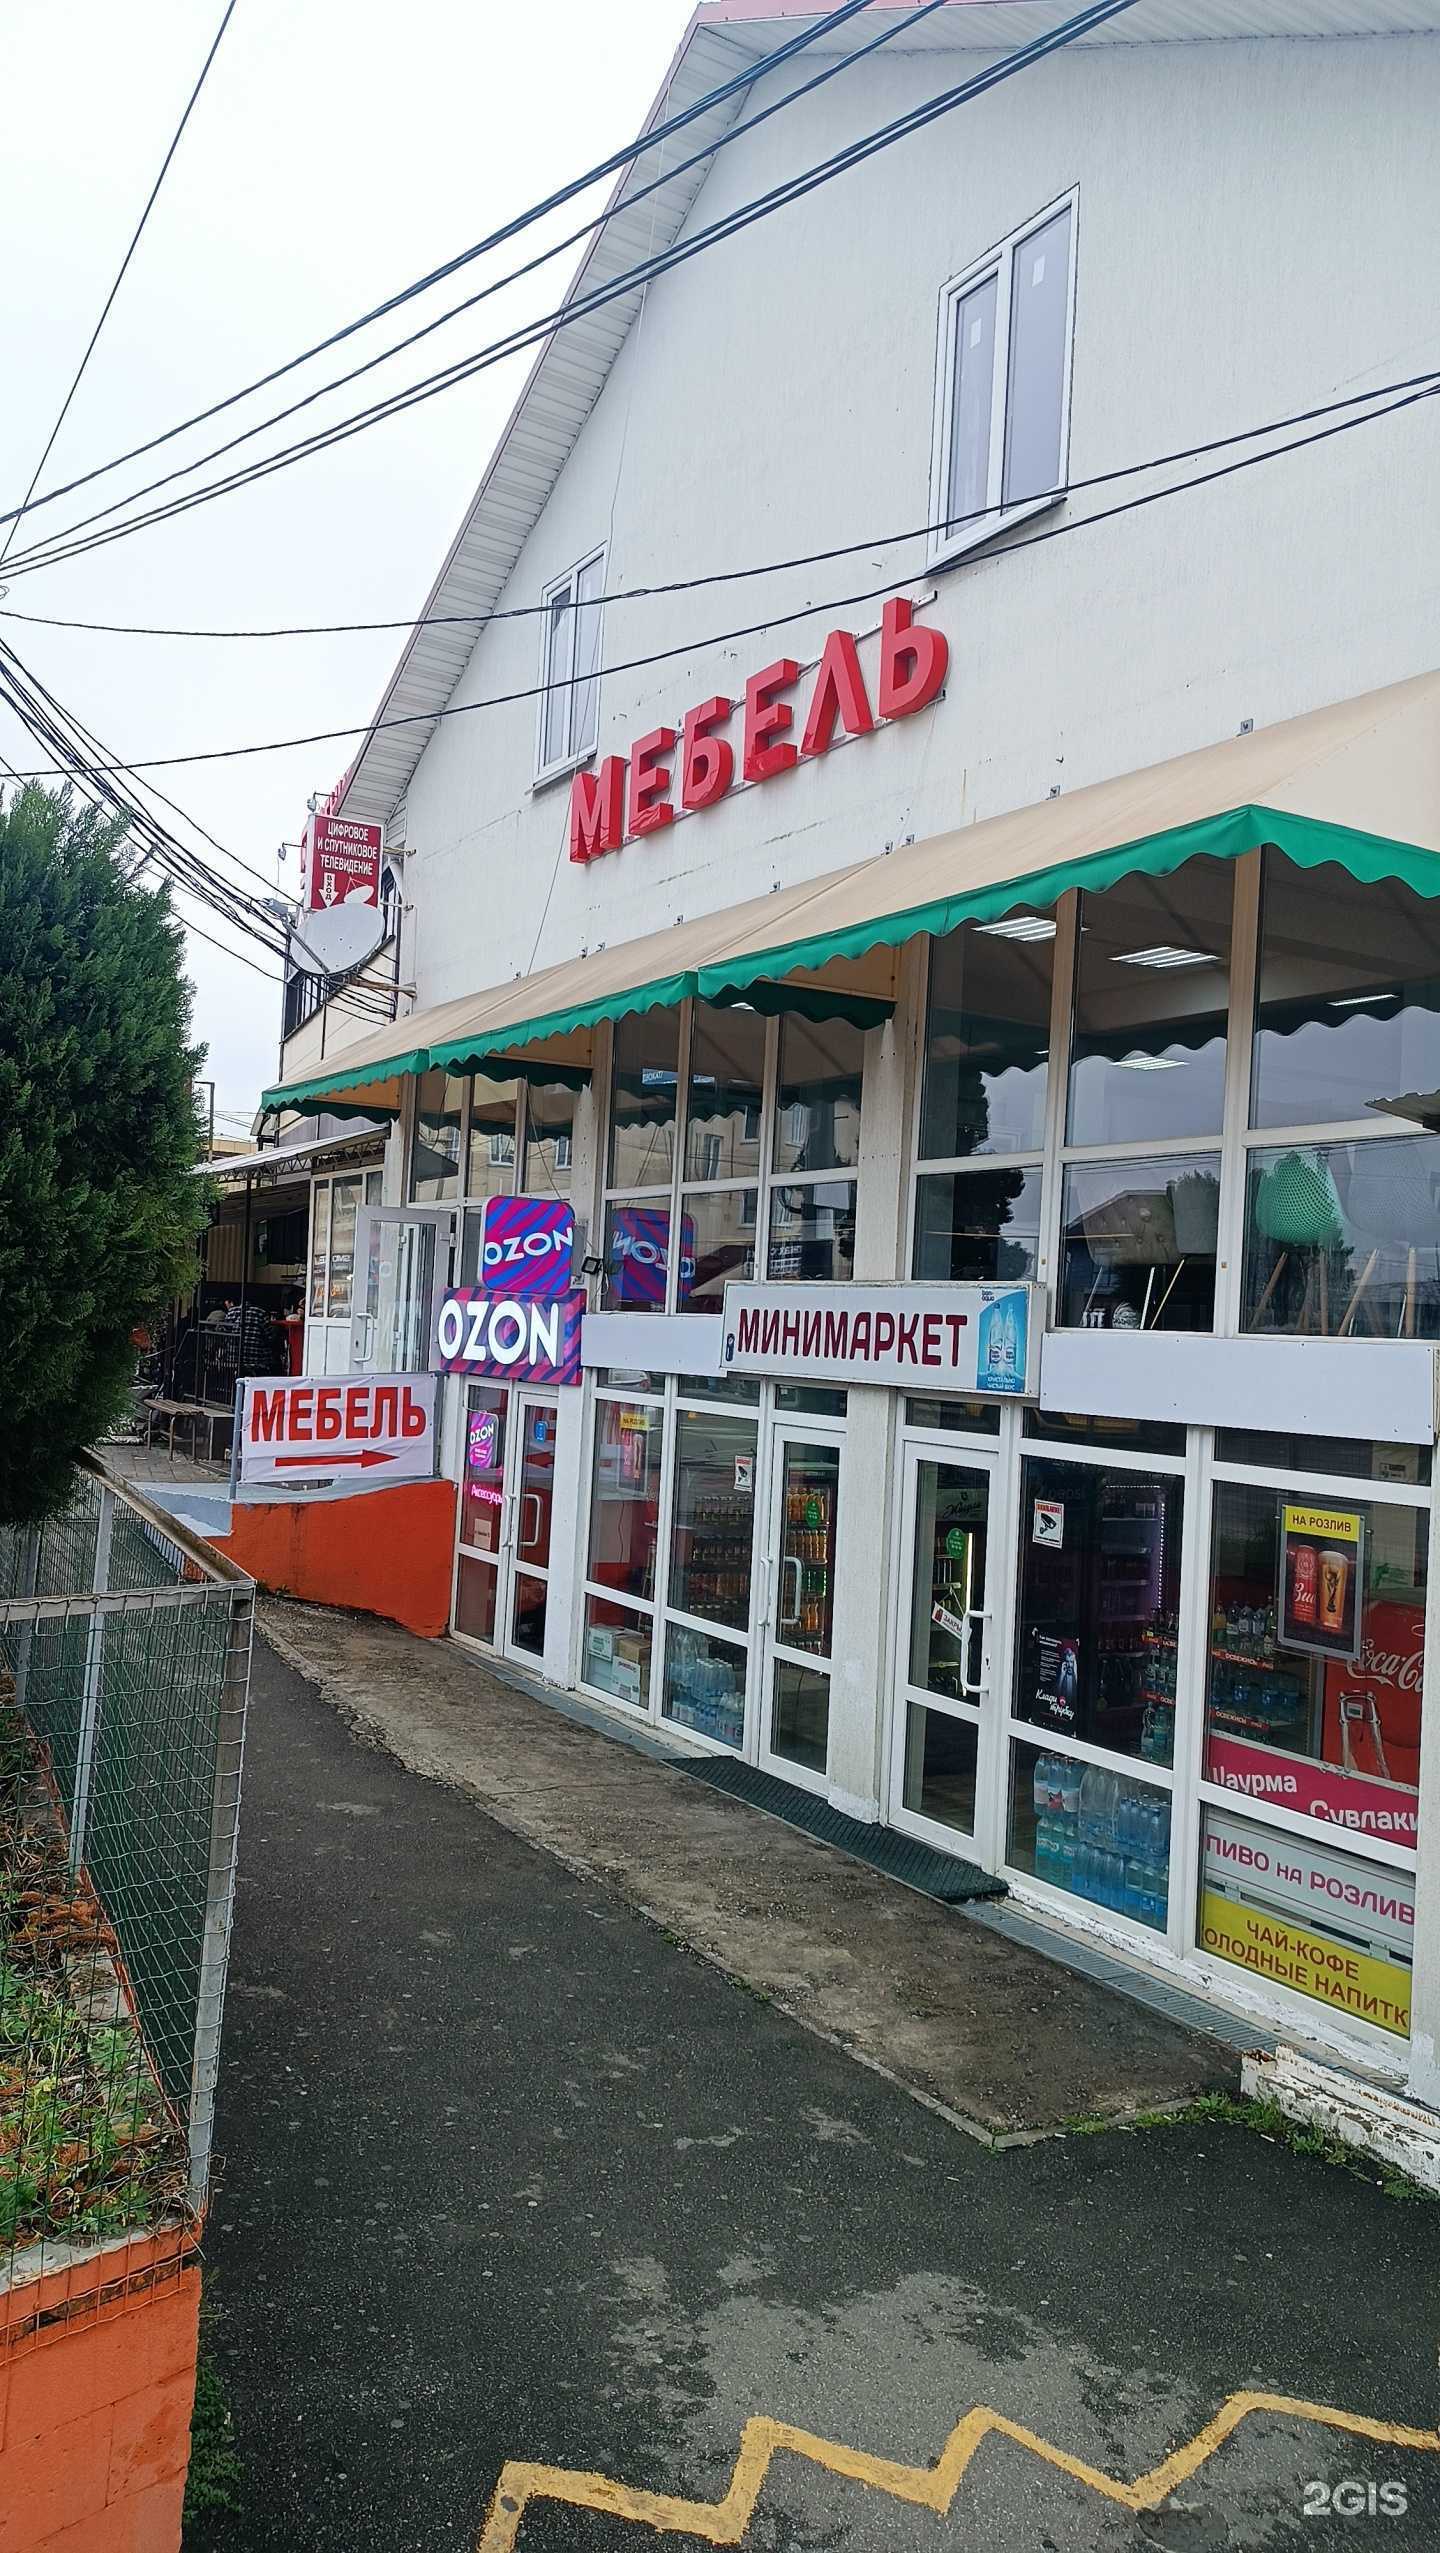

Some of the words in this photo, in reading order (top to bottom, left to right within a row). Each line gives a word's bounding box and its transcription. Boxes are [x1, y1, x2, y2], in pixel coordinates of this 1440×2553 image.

[570, 597, 948, 863] МЕБЕЛЬ
[317, 837, 324, 850] И
[324, 838, 378, 860] СПУТНИКОВОЕ
[327, 821, 369, 841] ЦИФРОВОЕ
[319, 854, 374, 876] ТЕЛЕВИДЕНИЕ
[484, 1227, 573, 1266] OZON
[438, 1299, 559, 1367] OZON
[737, 1308, 968, 1367] МИНИМАРКЕТ
[251, 1386, 427, 1442] МЕБЕЛЬ
[469, 1423, 494, 1445] OZON
[1292, 1514, 1307, 1526] НА
[1309, 1516, 1352, 1533] РОЗЛИВ
[1206, 1834, 1270, 1872] ПИВО
[1310, 1871, 1415, 1925] РОЗЛИВ
[1202, 1927, 1309, 1986] ОЛОДНЫЕ
[1246, 1919, 1360, 1982] ЧАЙ-КОФЕ
